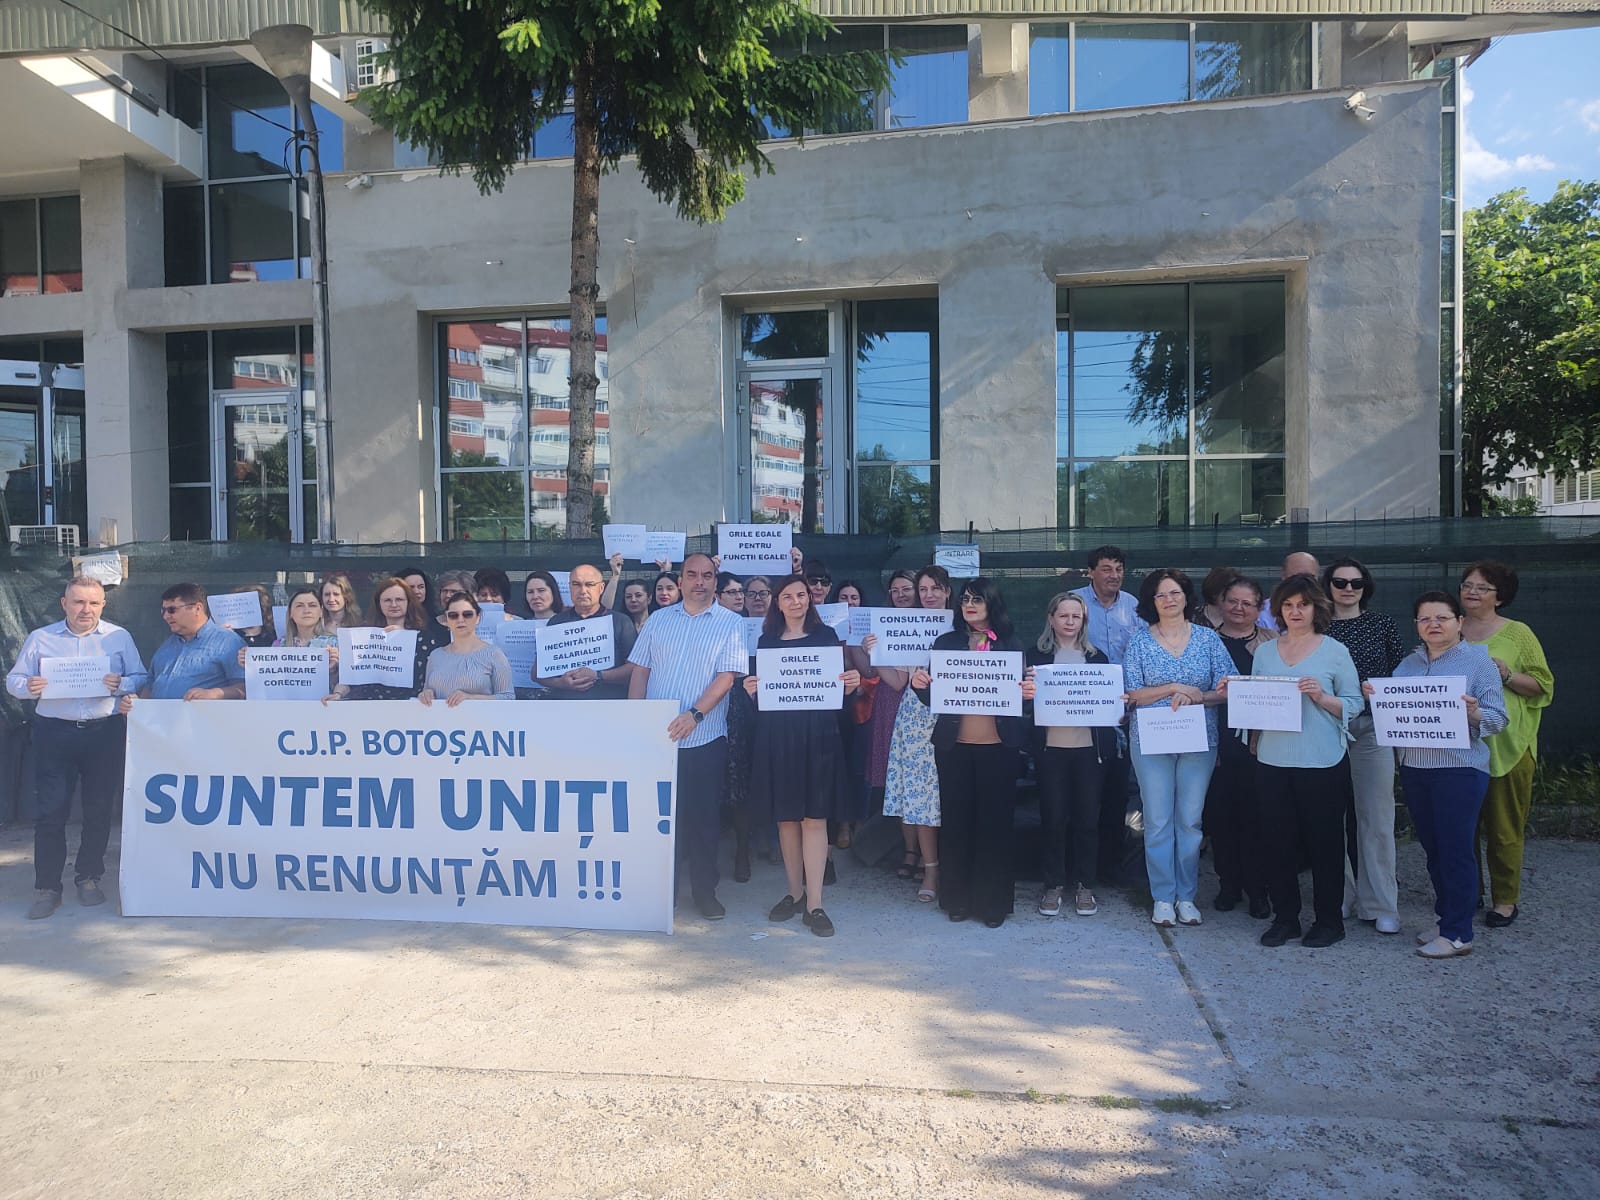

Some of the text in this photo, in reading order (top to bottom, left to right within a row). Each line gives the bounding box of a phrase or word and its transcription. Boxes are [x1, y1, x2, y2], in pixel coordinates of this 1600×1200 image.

[879, 615, 945, 623] CONSULTARE
[564, 626, 586, 636] STOP
[251, 654, 323, 662] VREM GRILE DE
[781, 655, 820, 663] GRILELE
[544, 664, 568, 672] VREM
[780, 668, 822, 676] VOASTRE
[803, 681, 837, 689] MUNCA
[971, 686, 998, 694] DOAR
[943, 699, 1010, 708] STATISTICILE!
[1387, 731, 1456, 739] STATISTICILE!
[277, 729, 526, 765] C.J.P. BOTOȘANI
[144, 773, 672, 849] SUNTEM UNIȚI !
[191, 847, 622, 907] NU RENUNȚĂM !!!
